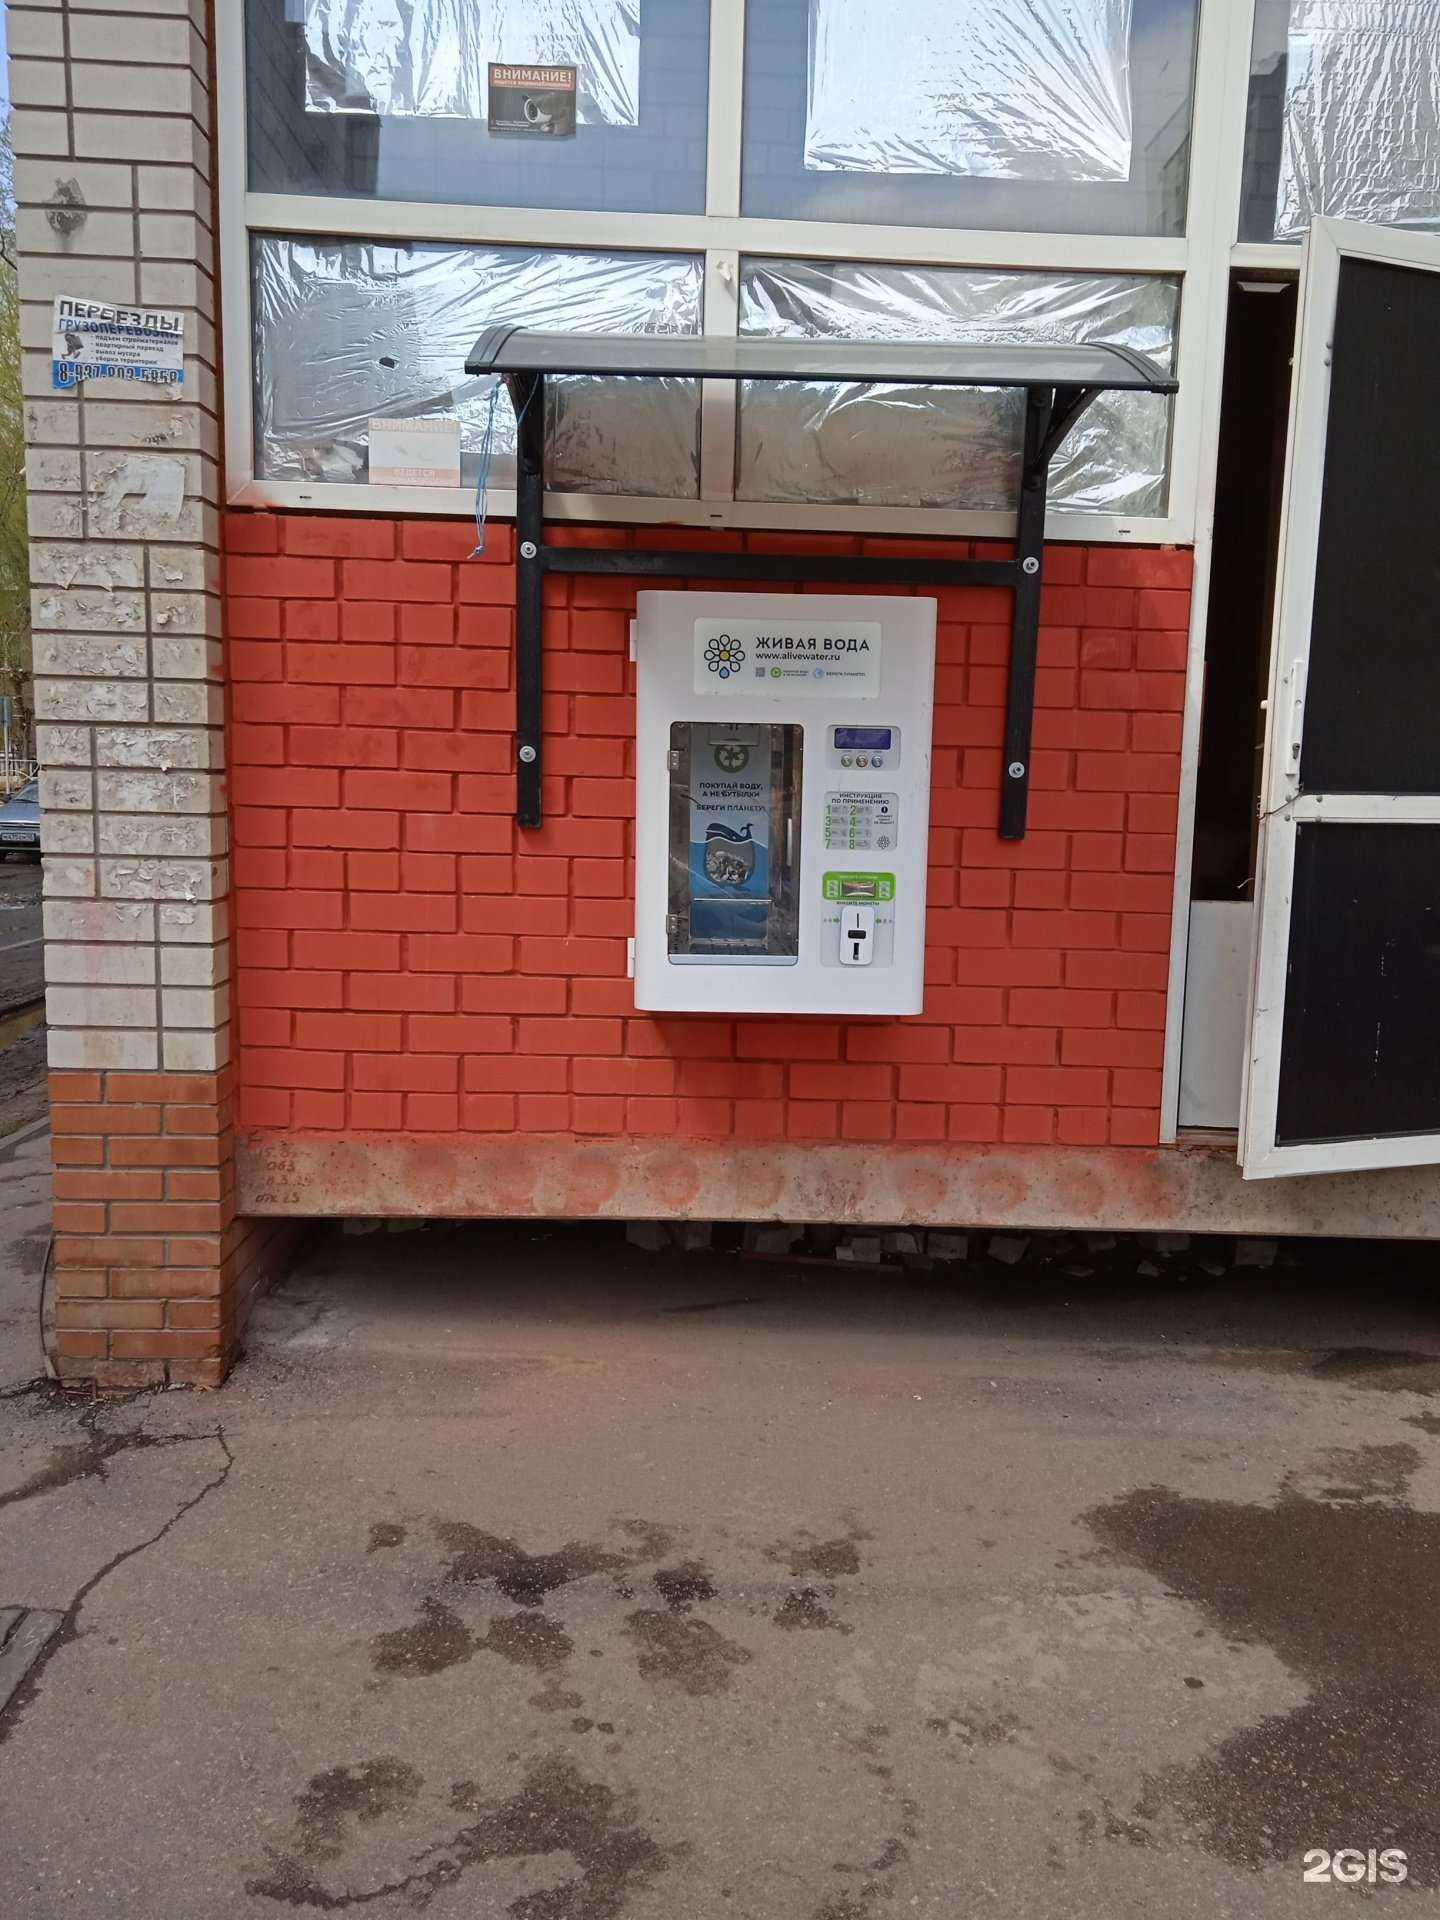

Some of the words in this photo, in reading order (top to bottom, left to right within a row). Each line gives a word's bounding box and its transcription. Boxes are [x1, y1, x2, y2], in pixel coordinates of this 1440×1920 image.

[494, 68, 572, 82] ВНИМАНИЕ!
[756, 637, 817, 650] ЖИВАЯ
[823, 638, 870, 652] ВОДА
[756, 652, 841, 661] www.alivewater.ru
[699, 781, 738, 789] ПОКУПАЙ
[839, 791, 883, 799] ИНСТРУКЦИЯ
[826, 805, 832, 815] 1
[849, 805, 857, 816] 2
[825, 816, 832, 827] 3
[825, 828, 832, 838] 5
[849, 828, 857, 838] 6
[825, 839, 832, 850] 7
[849, 839, 856, 850] 8
